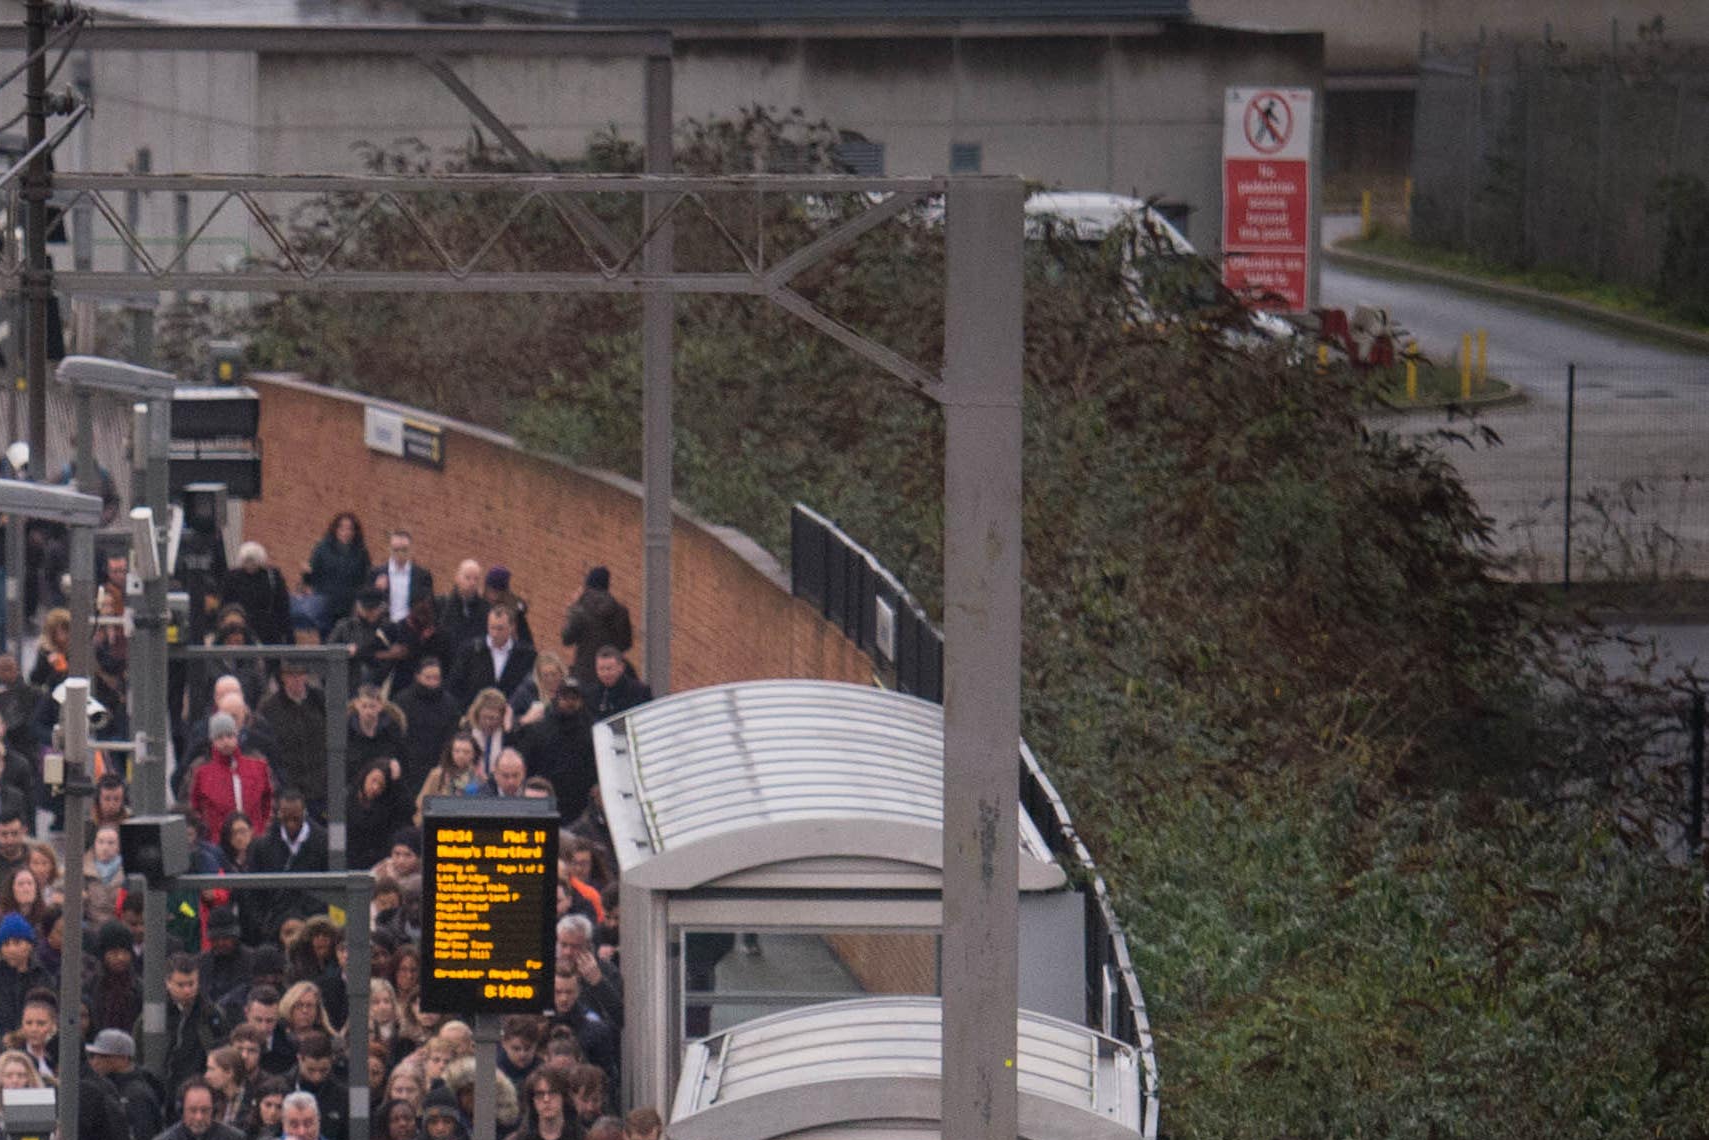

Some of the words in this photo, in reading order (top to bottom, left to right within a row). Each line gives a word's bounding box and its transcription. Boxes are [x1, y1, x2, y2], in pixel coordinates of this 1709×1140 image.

[1237, 179, 1297, 196] pedestrian
[503, 830, 529, 843] Plat
[496, 864, 517, 874] Page
[488, 969, 529, 980] Anglia
